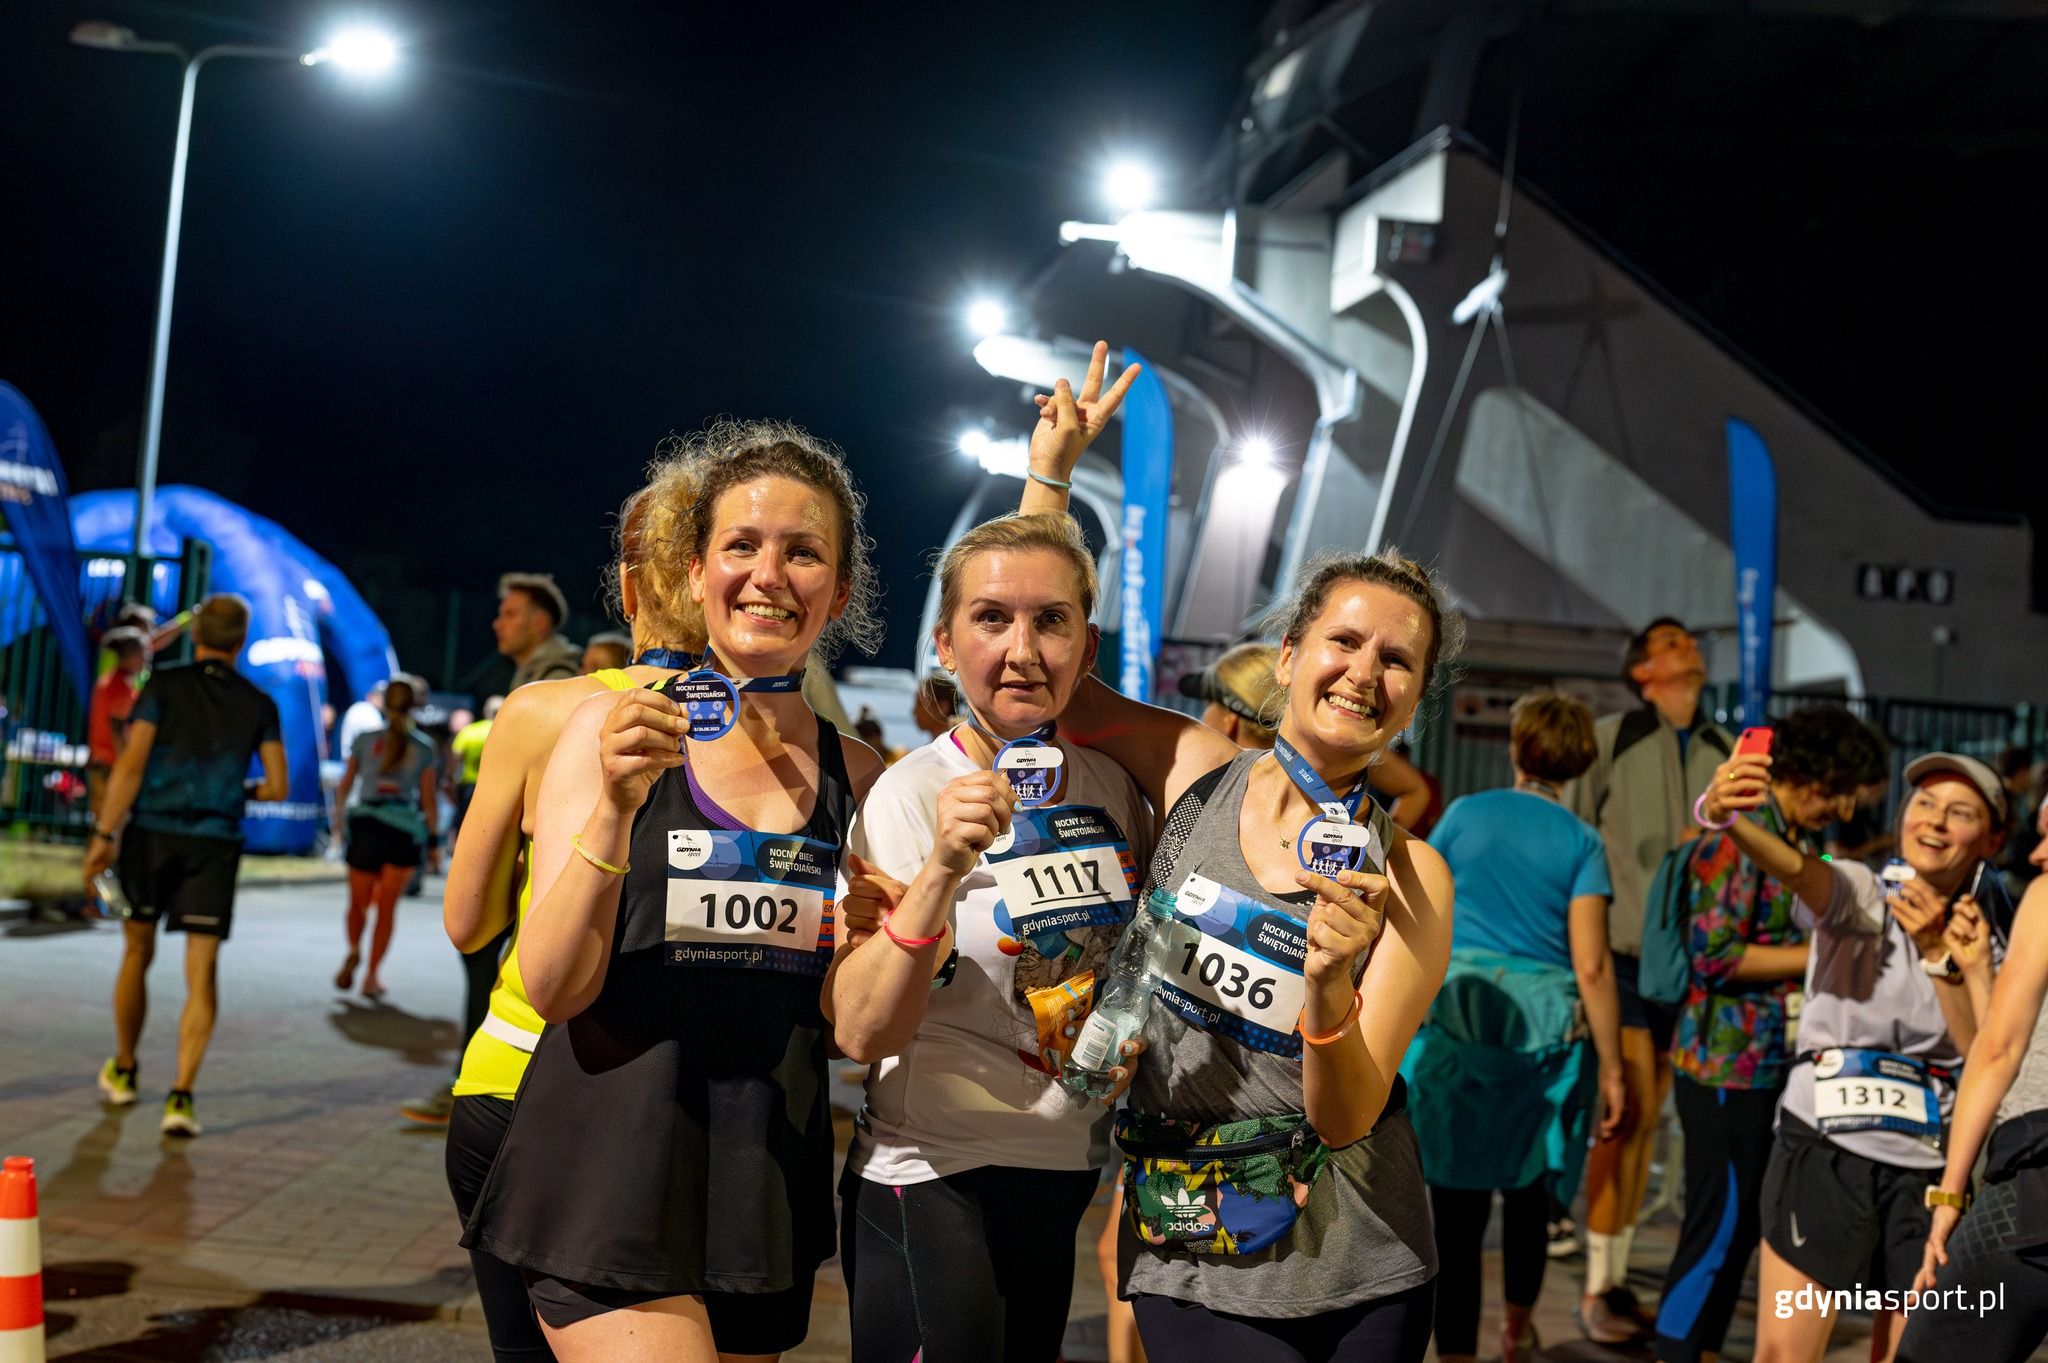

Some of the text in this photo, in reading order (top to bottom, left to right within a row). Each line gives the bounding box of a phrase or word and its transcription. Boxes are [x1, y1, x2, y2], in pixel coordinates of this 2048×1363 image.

[686, 690, 726, 700] ŚWIĘTOJAŃSKI
[1054, 816, 1080, 829] NOCNY
[1081, 815, 1096, 826] BIEG
[1058, 825, 1106, 839] ŚWIĘTOJAŃSKI
[1322, 832, 1344, 840] GDYNIA
[676, 846, 702, 854] GDYNIA
[769, 847, 815, 862] NOCNY BIEG
[769, 859, 822, 876] ŚWIĘTOJAŃSKI
[1023, 860, 1100, 899] 1117
[1184, 890, 1206, 903] GDYNIA
[700, 892, 799, 935] 1002
[1022, 908, 1091, 936] gdyniasport.pl
[1261, 921, 1308, 948] NOCNY BIE
[674, 947, 764, 963] gdyniasport.pl
[1180, 942, 1278, 1010] 1036
[1155, 984, 1222, 1025] dyniasport.pl
[1838, 1086, 1907, 1109] 1312
[1165, 1220, 1210, 1232] adidas
